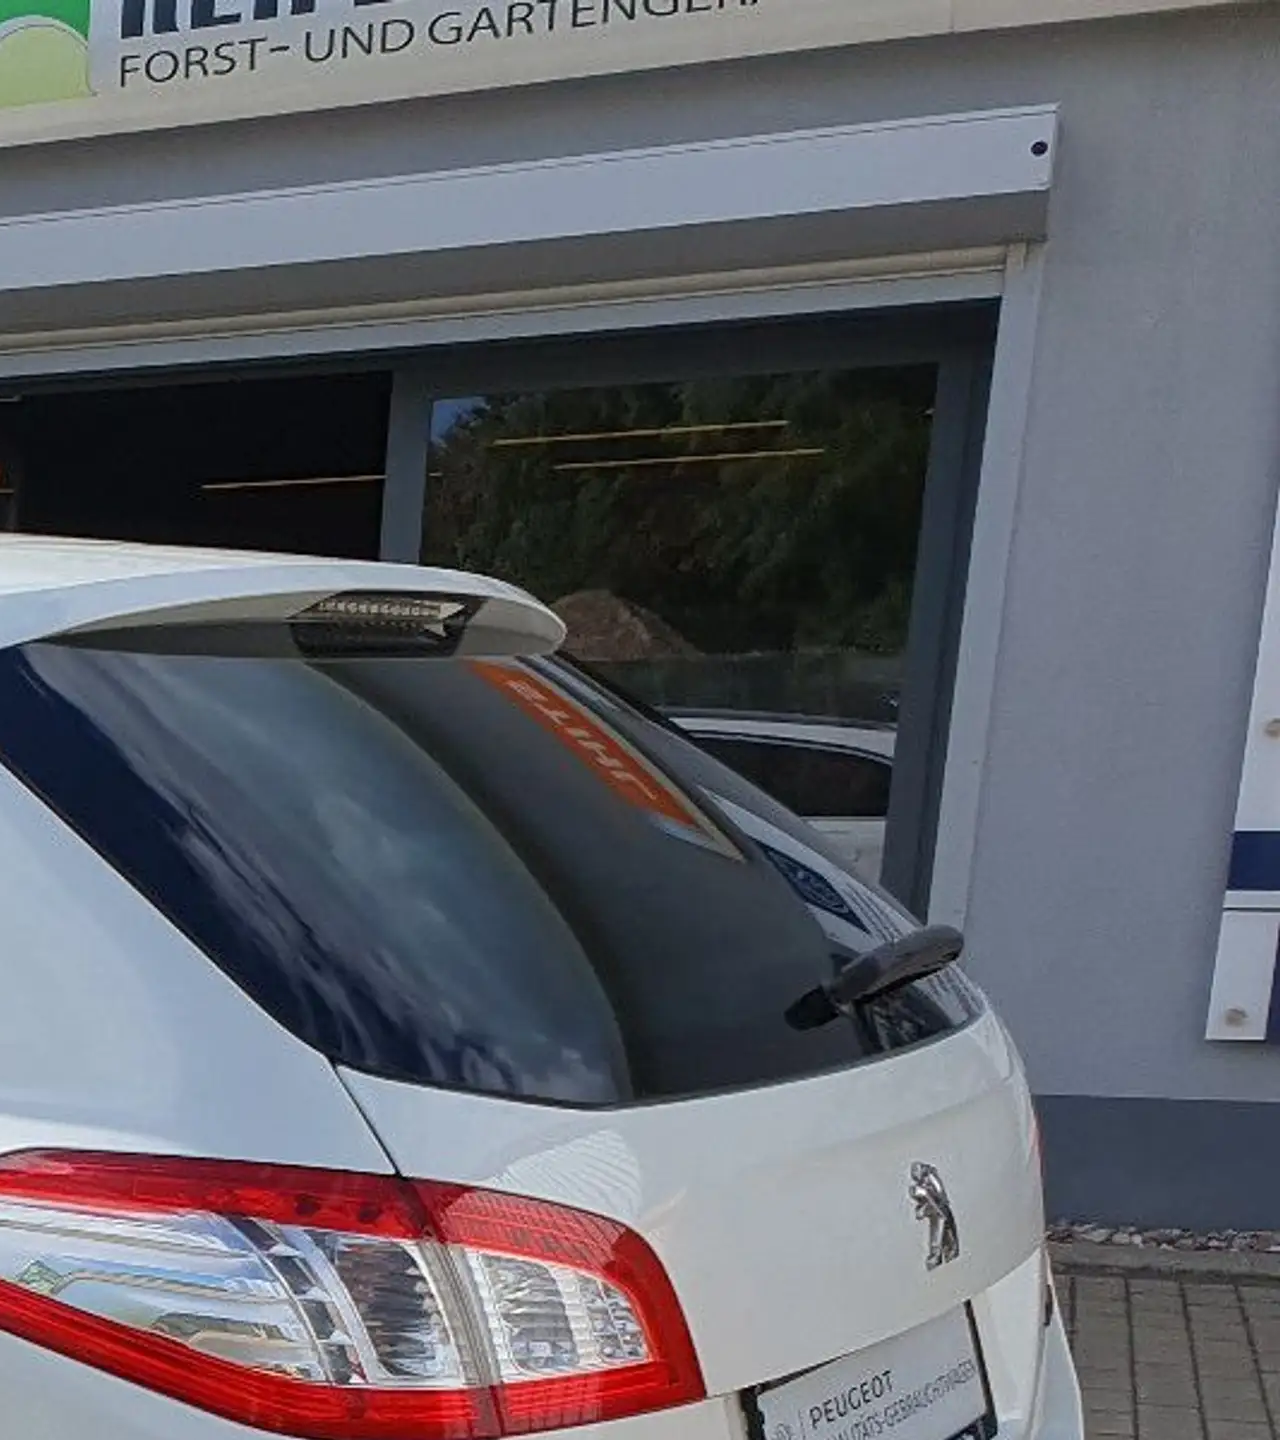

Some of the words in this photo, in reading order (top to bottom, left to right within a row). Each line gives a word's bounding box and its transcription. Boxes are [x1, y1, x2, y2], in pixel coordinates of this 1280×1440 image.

[120, 37, 290, 87] FORST-
[304, 19, 415, 62] UND
[810, 1370, 893, 1430] PEUGEOT
